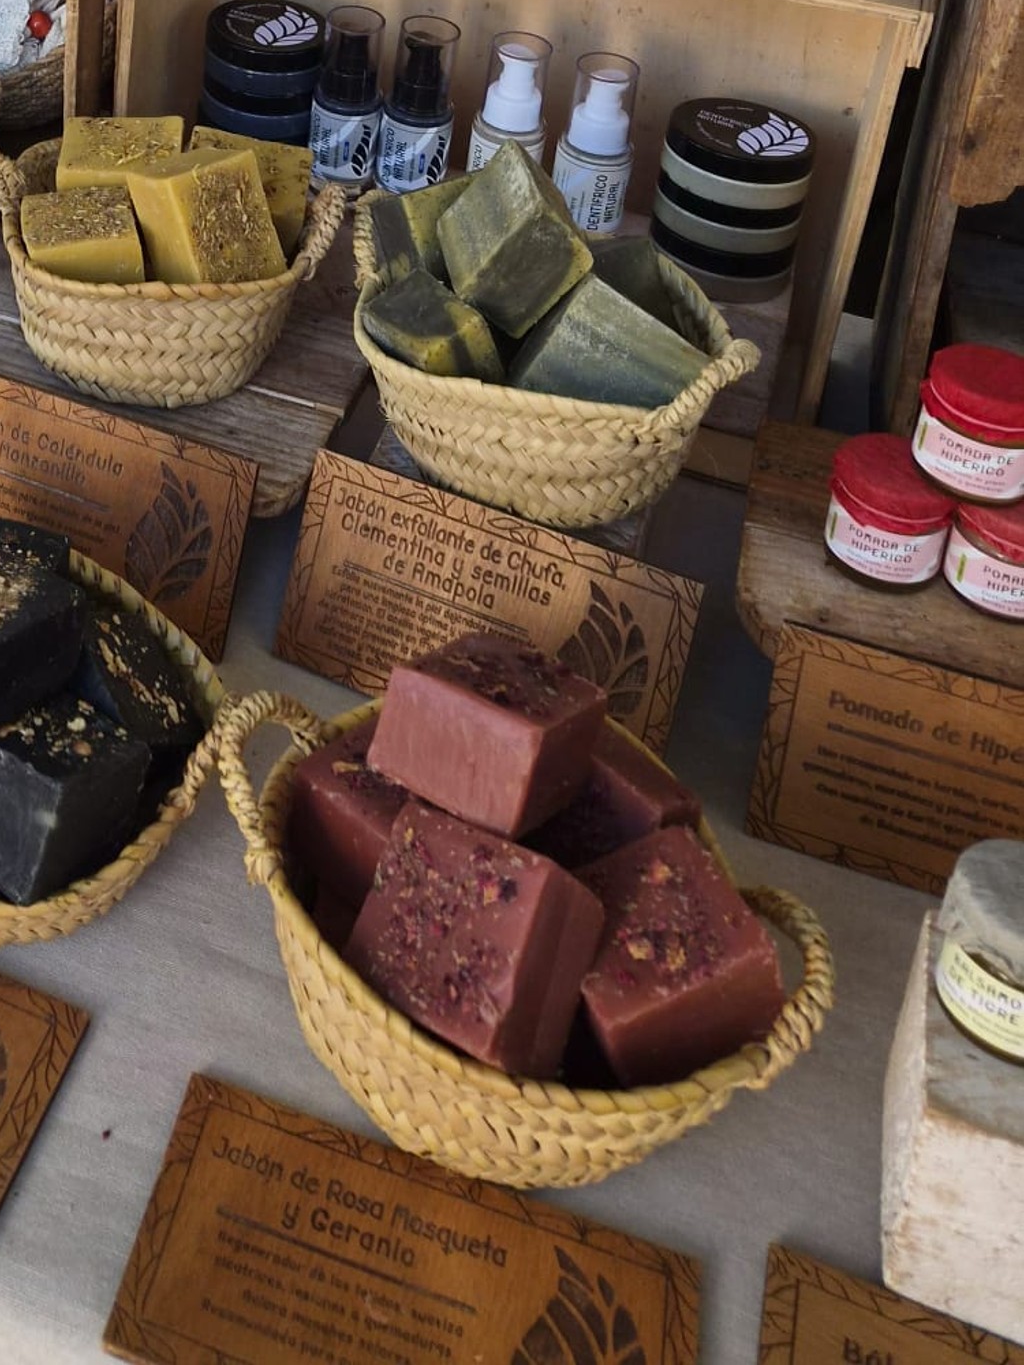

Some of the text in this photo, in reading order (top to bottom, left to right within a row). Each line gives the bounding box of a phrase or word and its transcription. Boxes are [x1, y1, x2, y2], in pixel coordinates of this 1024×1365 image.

[319, 128, 332, 165] NATURAL
[382, 127, 395, 183] DENTIFRICO
[393, 141, 407, 181] NATURAL
[587, 174, 608, 231] DENTIFRICO
[604, 181, 620, 224] NATURAL
[10, 421, 31, 444] de
[36, 427, 125, 478] Caléndula
[939, 432, 1015, 466] POMADA DE
[941, 447, 1006, 478] HIPERICO
[334, 487, 566, 590] Jabón exfoliante de Chufa,
[341, 512, 551, 607] Clementina y semillas
[848, 522, 921, 553] POMADA DE
[850, 537, 912, 563] HIPERICO
[383, 554, 495, 609] de Amapola
[829, 689, 924, 733] Pomada
[932, 720, 961, 746] de
[972, 987, 1018, 1027] TIGRE
[210, 1134, 512, 1276] Jabón de Rosa Mosqueta
[278, 1199, 420, 1268] y Geranio
